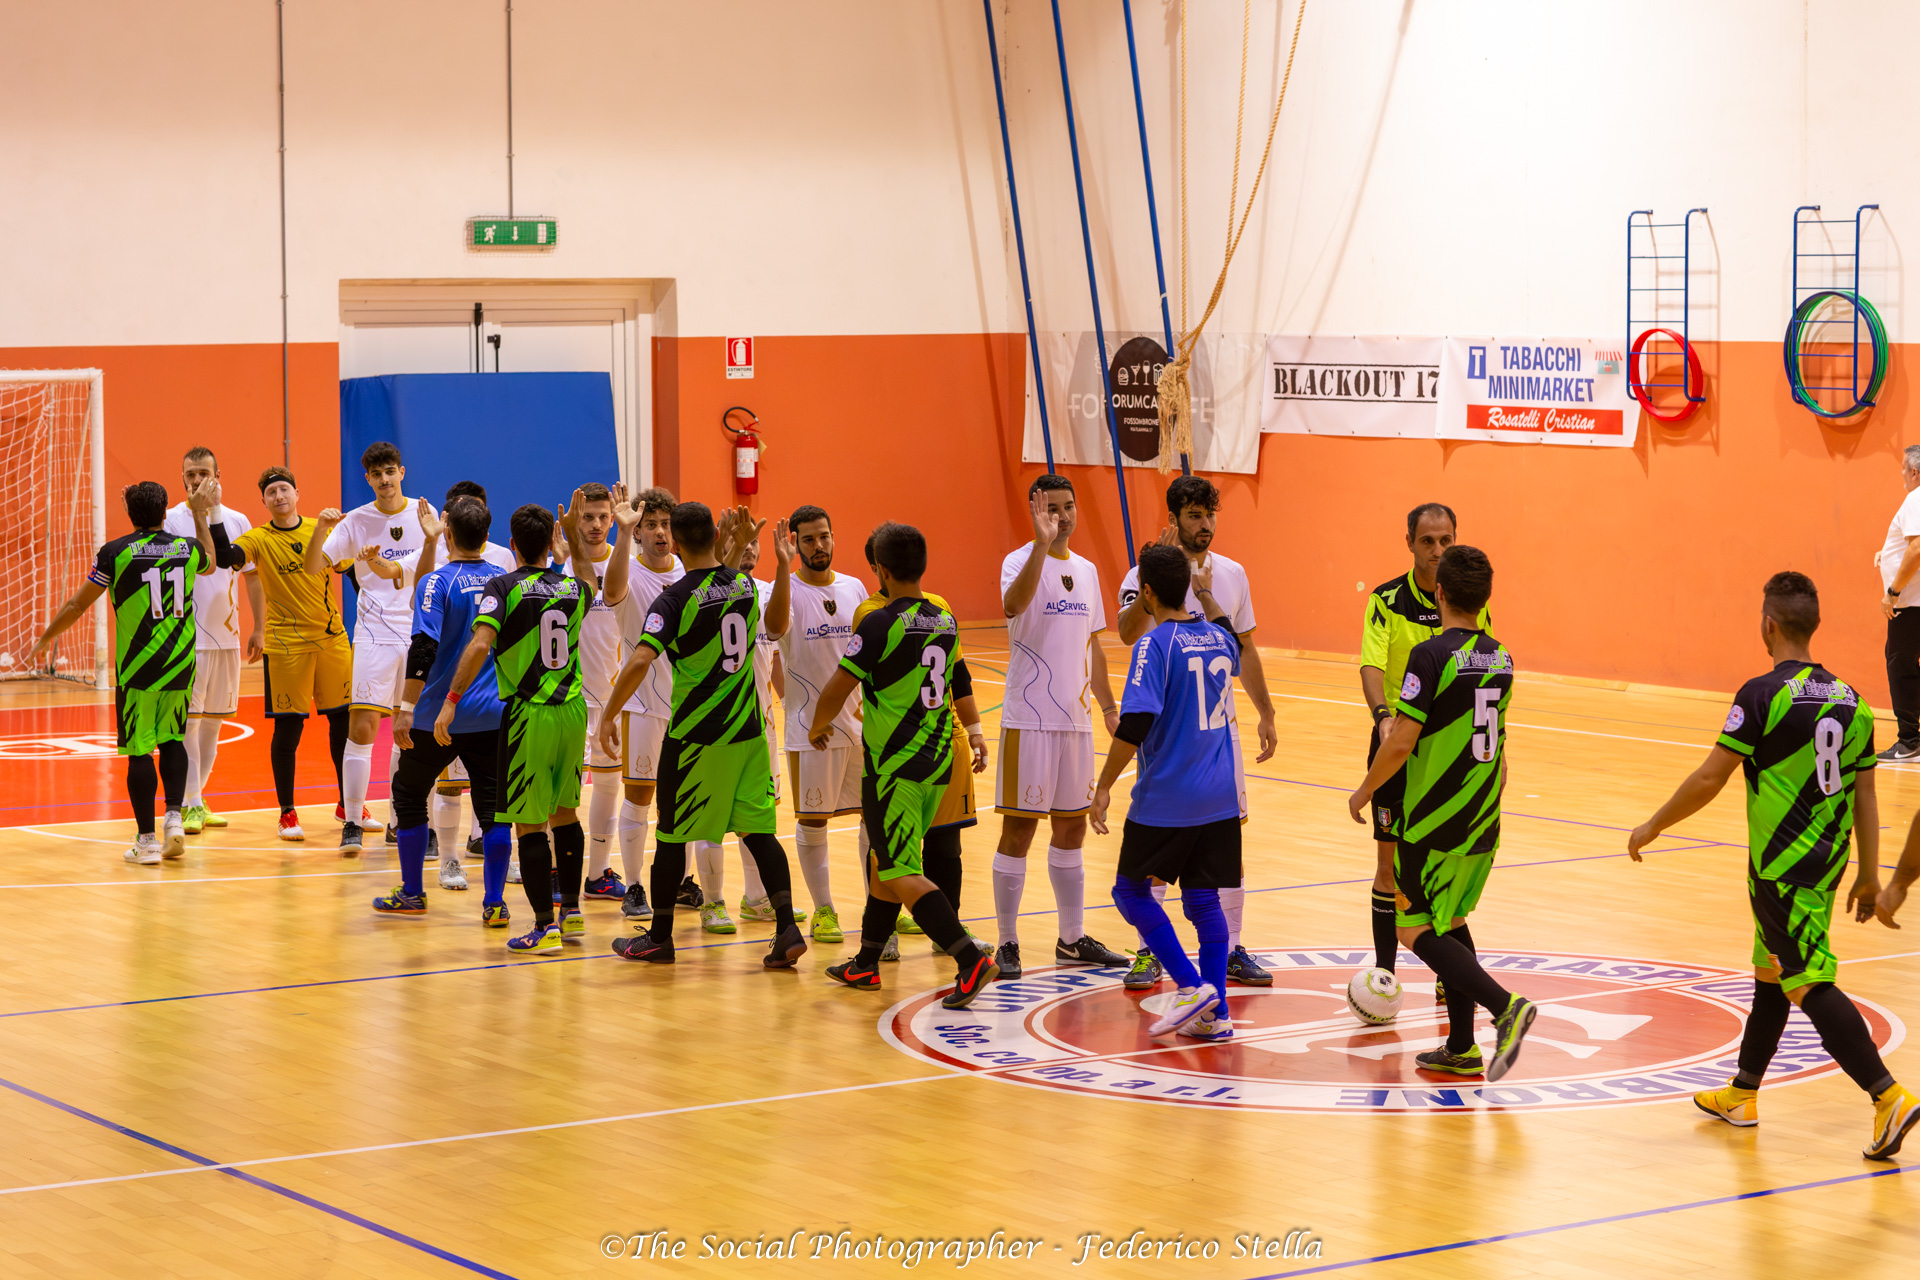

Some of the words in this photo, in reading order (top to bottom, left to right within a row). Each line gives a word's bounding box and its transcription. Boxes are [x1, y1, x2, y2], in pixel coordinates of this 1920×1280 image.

[1274, 368, 1406, 398] BLACKOUT
[1416, 370, 1440, 398] 17
[1500, 346, 1581, 372] TABACCHI
[1112, 394, 1159, 409] ORUMCA
[1488, 375, 1595, 403] MINIMARKET
[1124, 417, 1159, 426] FOSSOMBRONE
[1487, 407, 1541, 429] Rosatelli
[1544, 408, 1596, 432] Cristian
[141, 566, 185, 620] 11
[1046, 599, 1087, 613] ALLSERVICE
[539, 609, 570, 670] 6
[721, 612, 748, 674] 9
[806, 623, 852, 637] ALLSERVICE
[920, 645, 947, 710] 3
[1131, 636, 1152, 687] makay
[1188, 655, 1233, 731] 12
[1471, 687, 1502, 762] 5
[1814, 717, 1844, 796] 8
[934, 1024, 993, 1049] Soc.
[1110, 1079, 1156, 1090] a
